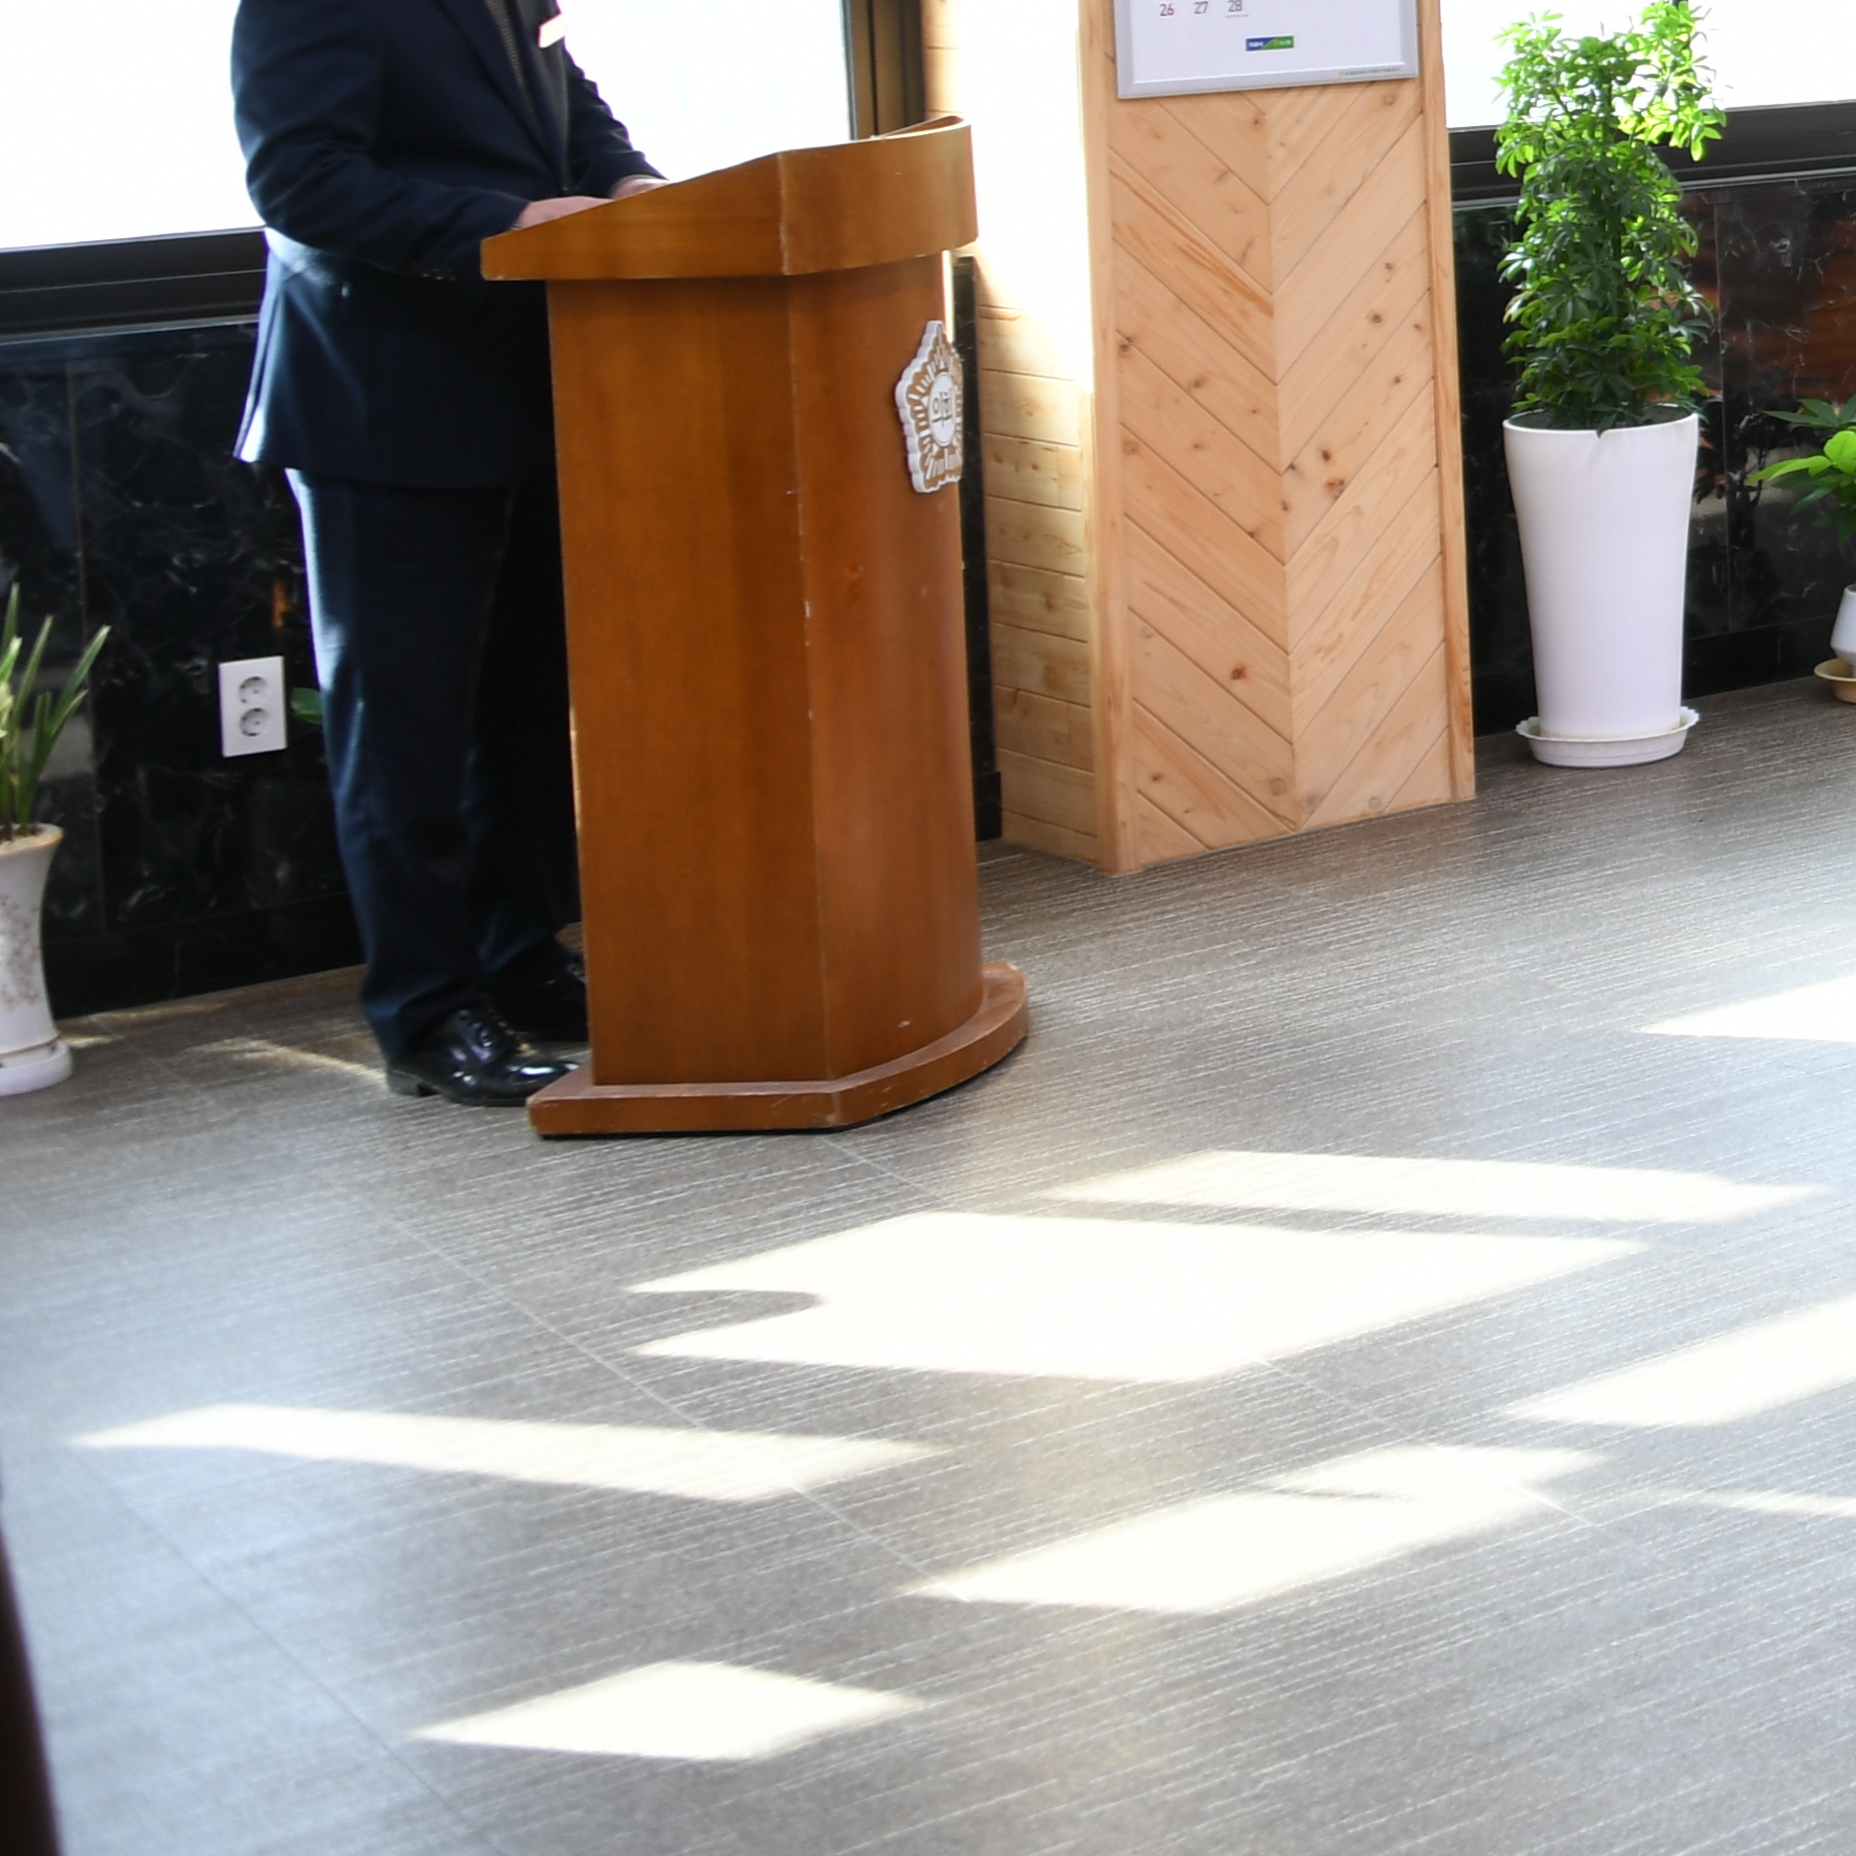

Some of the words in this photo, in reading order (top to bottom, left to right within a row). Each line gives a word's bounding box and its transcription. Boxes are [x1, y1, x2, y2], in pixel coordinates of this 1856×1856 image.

[1160, 4, 1174, 16] 26
[1194, 1, 1208, 14] 27
[1228, 0, 1242, 12] 28
